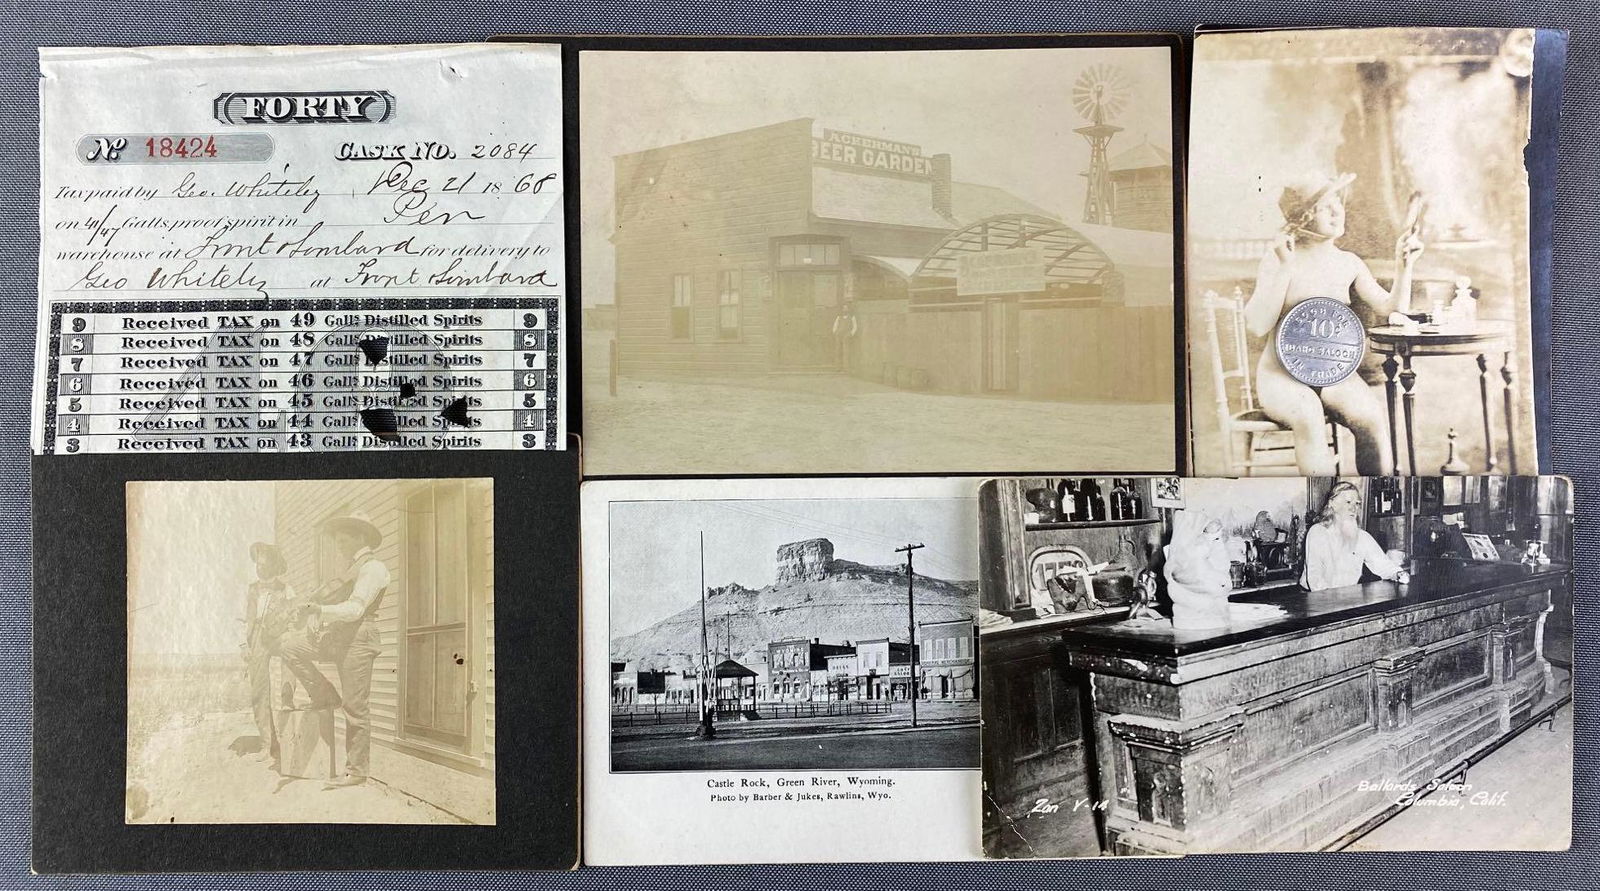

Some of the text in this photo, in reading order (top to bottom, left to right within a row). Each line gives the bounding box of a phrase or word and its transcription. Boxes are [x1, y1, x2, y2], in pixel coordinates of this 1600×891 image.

[243, 96, 377, 121] FORTY
[145, 135, 218, 159] 18424
[334, 141, 406, 161] CASK
[471, 142, 538, 163] 2084
[72, 318, 86, 332] 9
[123, 317, 208, 329] Received
[218, 317, 253, 328] TAX
[261, 319, 279, 327] on
[290, 313, 315, 326] 49
[364, 314, 428, 326] Distilled
[434, 315, 483, 327] Spirits
[523, 314, 537, 327] 9
[71, 338, 84, 352] 8
[122, 337, 208, 349] Received
[218, 336, 253, 347] TAX
[260, 338, 279, 346] on
[290, 332, 315, 345] 48
[434, 335, 483, 347] Spirits
[523, 334, 536, 347] 8
[71, 358, 83, 371] 7
[121, 356, 208, 369] Received
[217, 356, 252, 367] TAX
[260, 357, 278, 367] on
[289, 352, 313, 365] 47
[434, 355, 483, 368] Spirits
[524, 353, 536, 367] 7
[69, 378, 83, 392] 6
[120, 376, 206, 390] Received
[216, 376, 251, 388] TAX
[259, 378, 277, 388] on
[288, 374, 314, 387] 46
[433, 375, 483, 388] Spirits
[523, 374, 537, 387] 6
[68, 398, 82, 412] 5
[120, 397, 205, 410] Received
[216, 397, 250, 408] TAX
[258, 399, 276, 407] on
[288, 393, 312, 407] 45
[523, 394, 535, 407] 5
[67, 419, 80, 432] 4
[118, 418, 204, 430] Received
[215, 417, 249, 429] TAX
[258, 419, 276, 428] on
[287, 414, 312, 427] 44
[523, 414, 535, 428] 4
[66, 438, 80, 452] 3
[118, 438, 204, 450] Received
[214, 437, 248, 449] TAX
[257, 439, 275, 448] on
[286, 433, 311, 446] 43
[432, 435, 482, 449] Spirits
[522, 434, 536, 448] 3
[707, 776, 896, 789] Castle Rock, Green River, Wyoming.
[710, 794, 736, 802] Photo
[739, 793, 750, 803] by
[753, 793, 782, 801] Barber
[797, 792, 824, 802] Jukes,
[827, 791, 865, 801] Rawlins,
[867, 791, 892, 801] Wyo.
